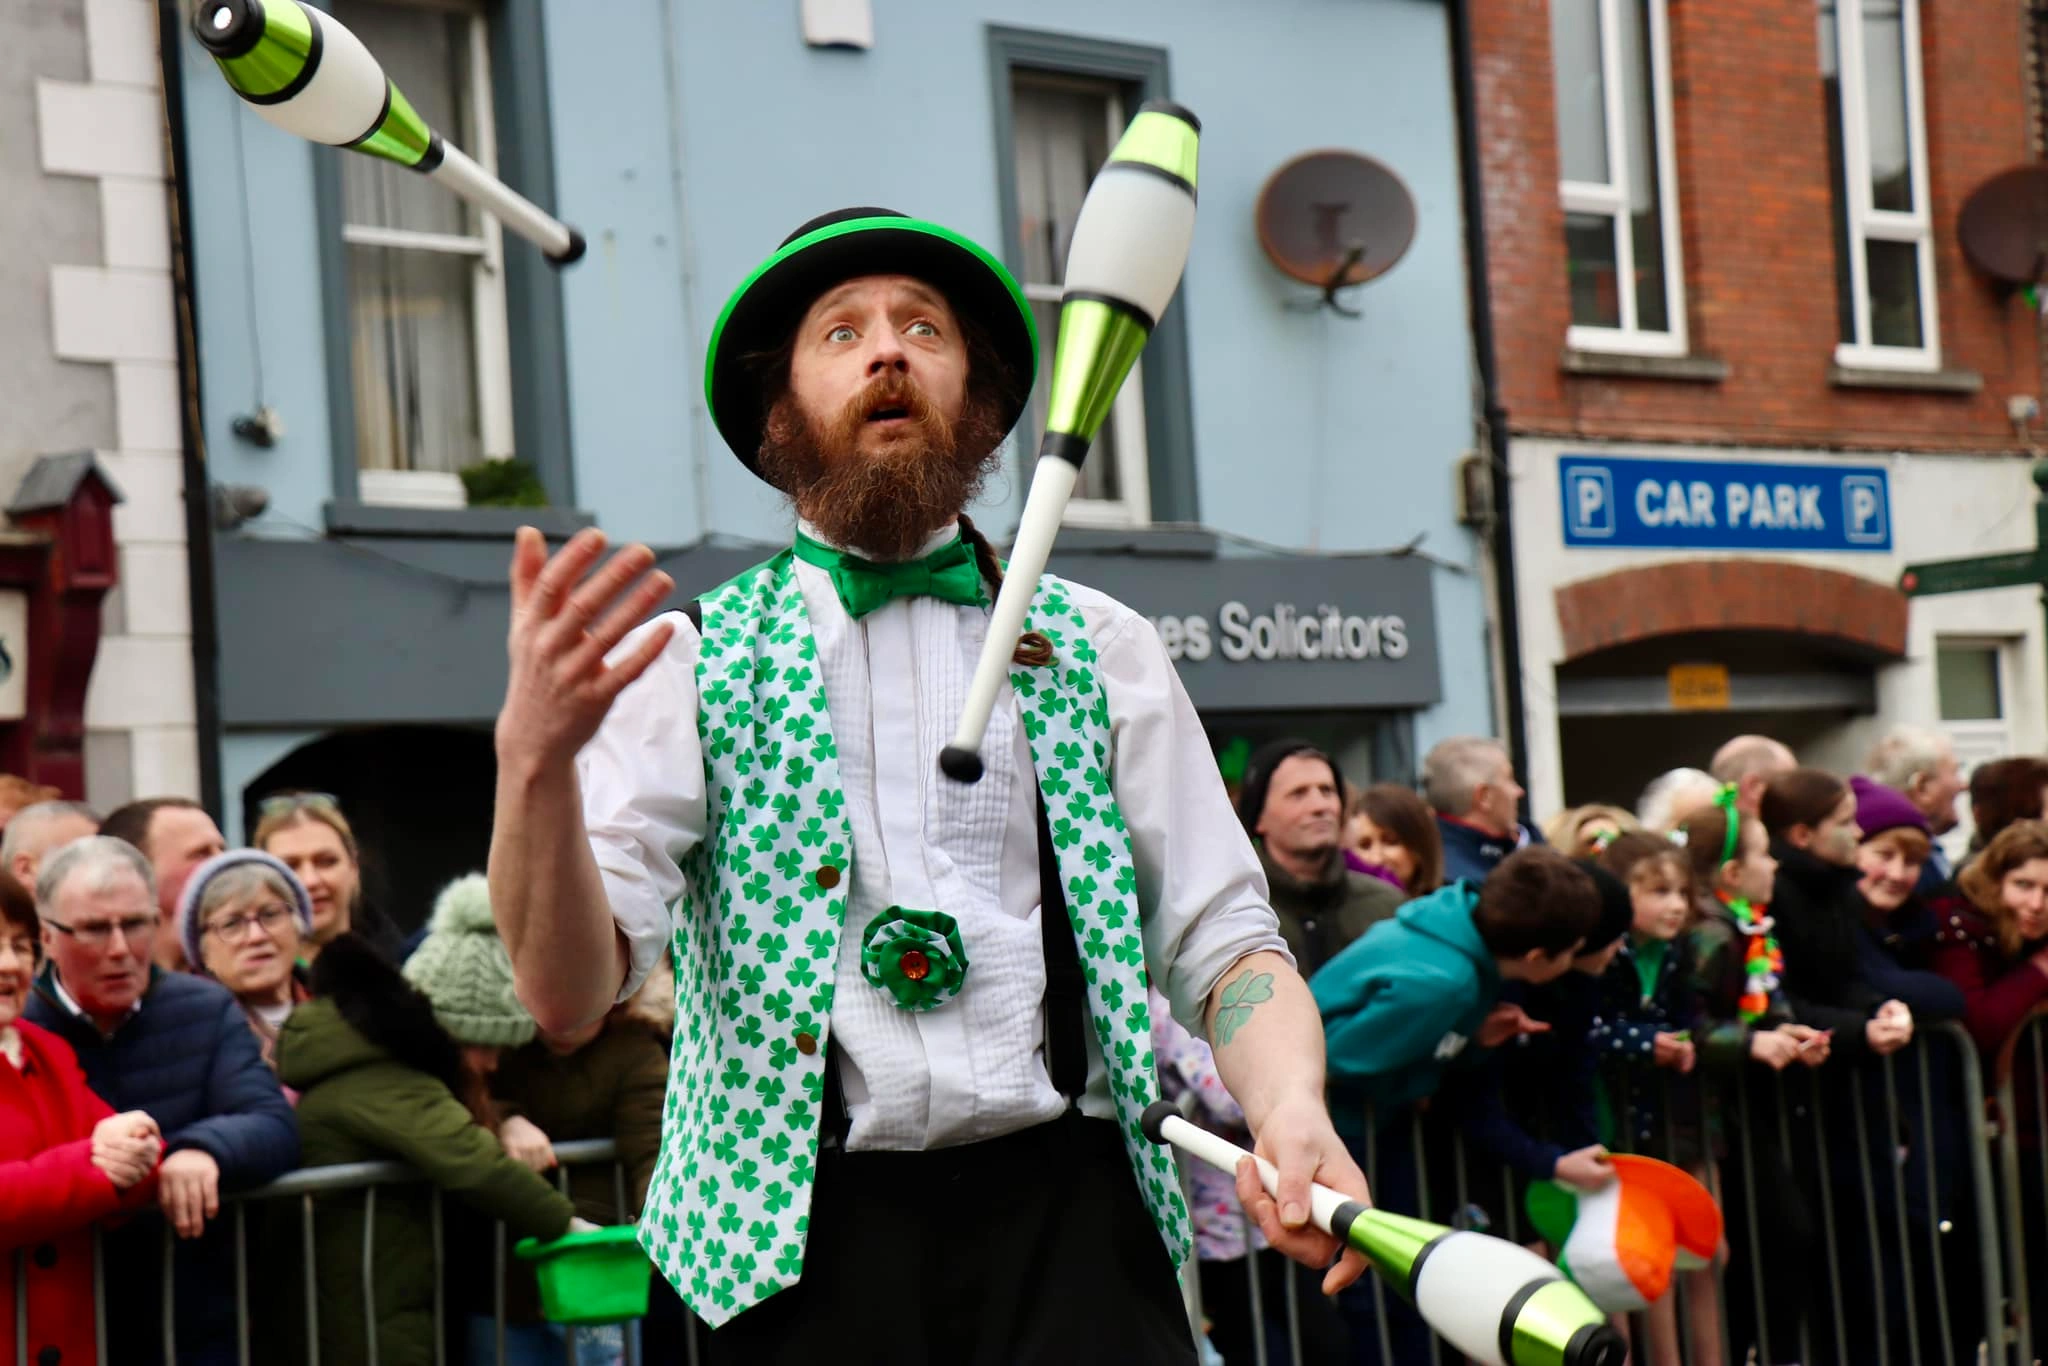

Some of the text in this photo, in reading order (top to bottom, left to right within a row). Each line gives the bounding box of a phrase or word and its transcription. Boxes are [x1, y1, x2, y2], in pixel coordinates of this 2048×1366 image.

[1577, 477, 1877, 533] P CAR PARK P
[1147, 600, 1409, 661] es Solicitors
